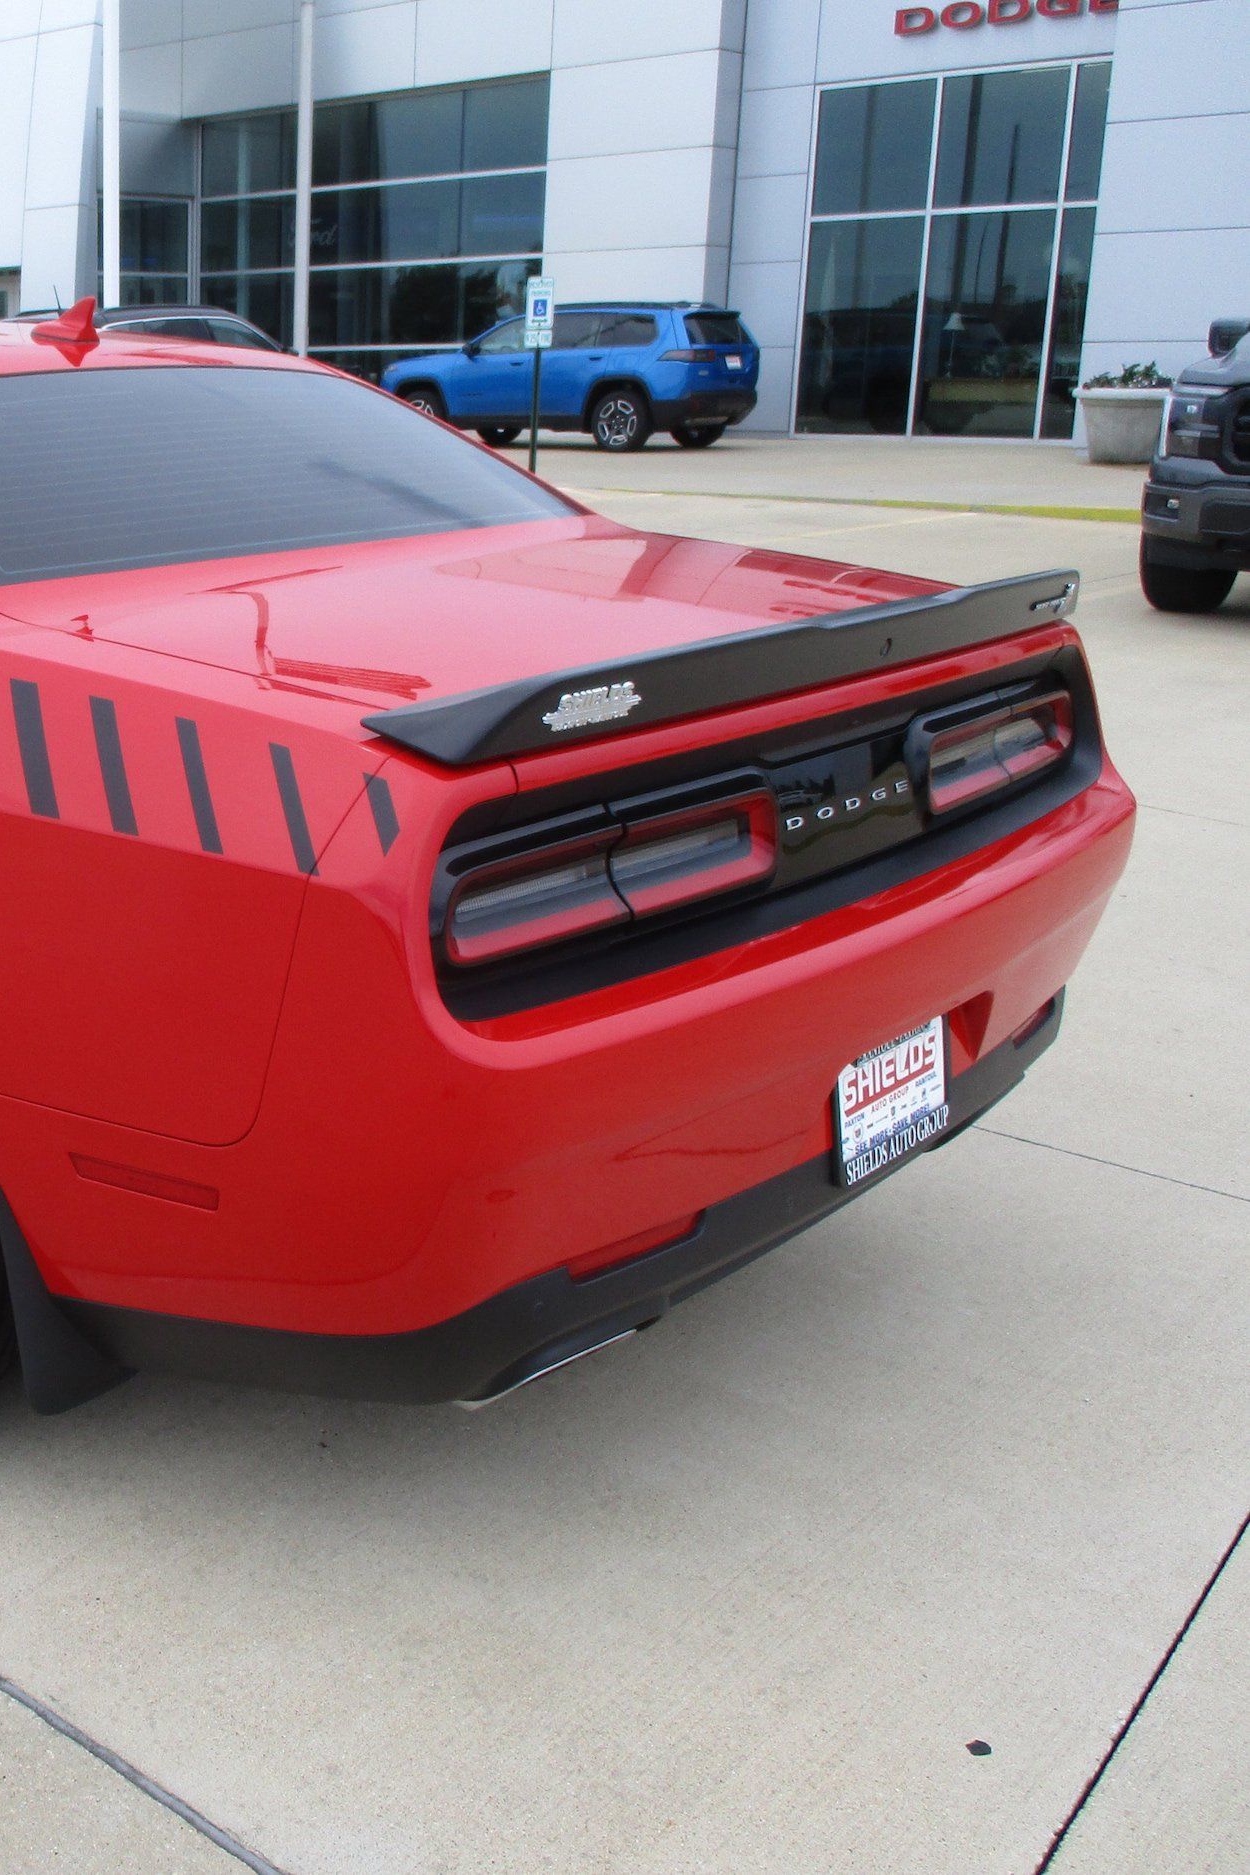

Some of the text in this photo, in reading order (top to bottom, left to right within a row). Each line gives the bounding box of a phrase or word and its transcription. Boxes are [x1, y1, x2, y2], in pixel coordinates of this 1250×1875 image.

[785, 780, 909, 831] DODGE
[842, 1033, 937, 1111] SHIELDS
[870, 1097, 888, 1114] AUTO
[889, 1085, 910, 1105] GROUP
[845, 1103, 949, 1186] SHIELDS AUTO GROUP
[855, 1140, 868, 1155] SEE
